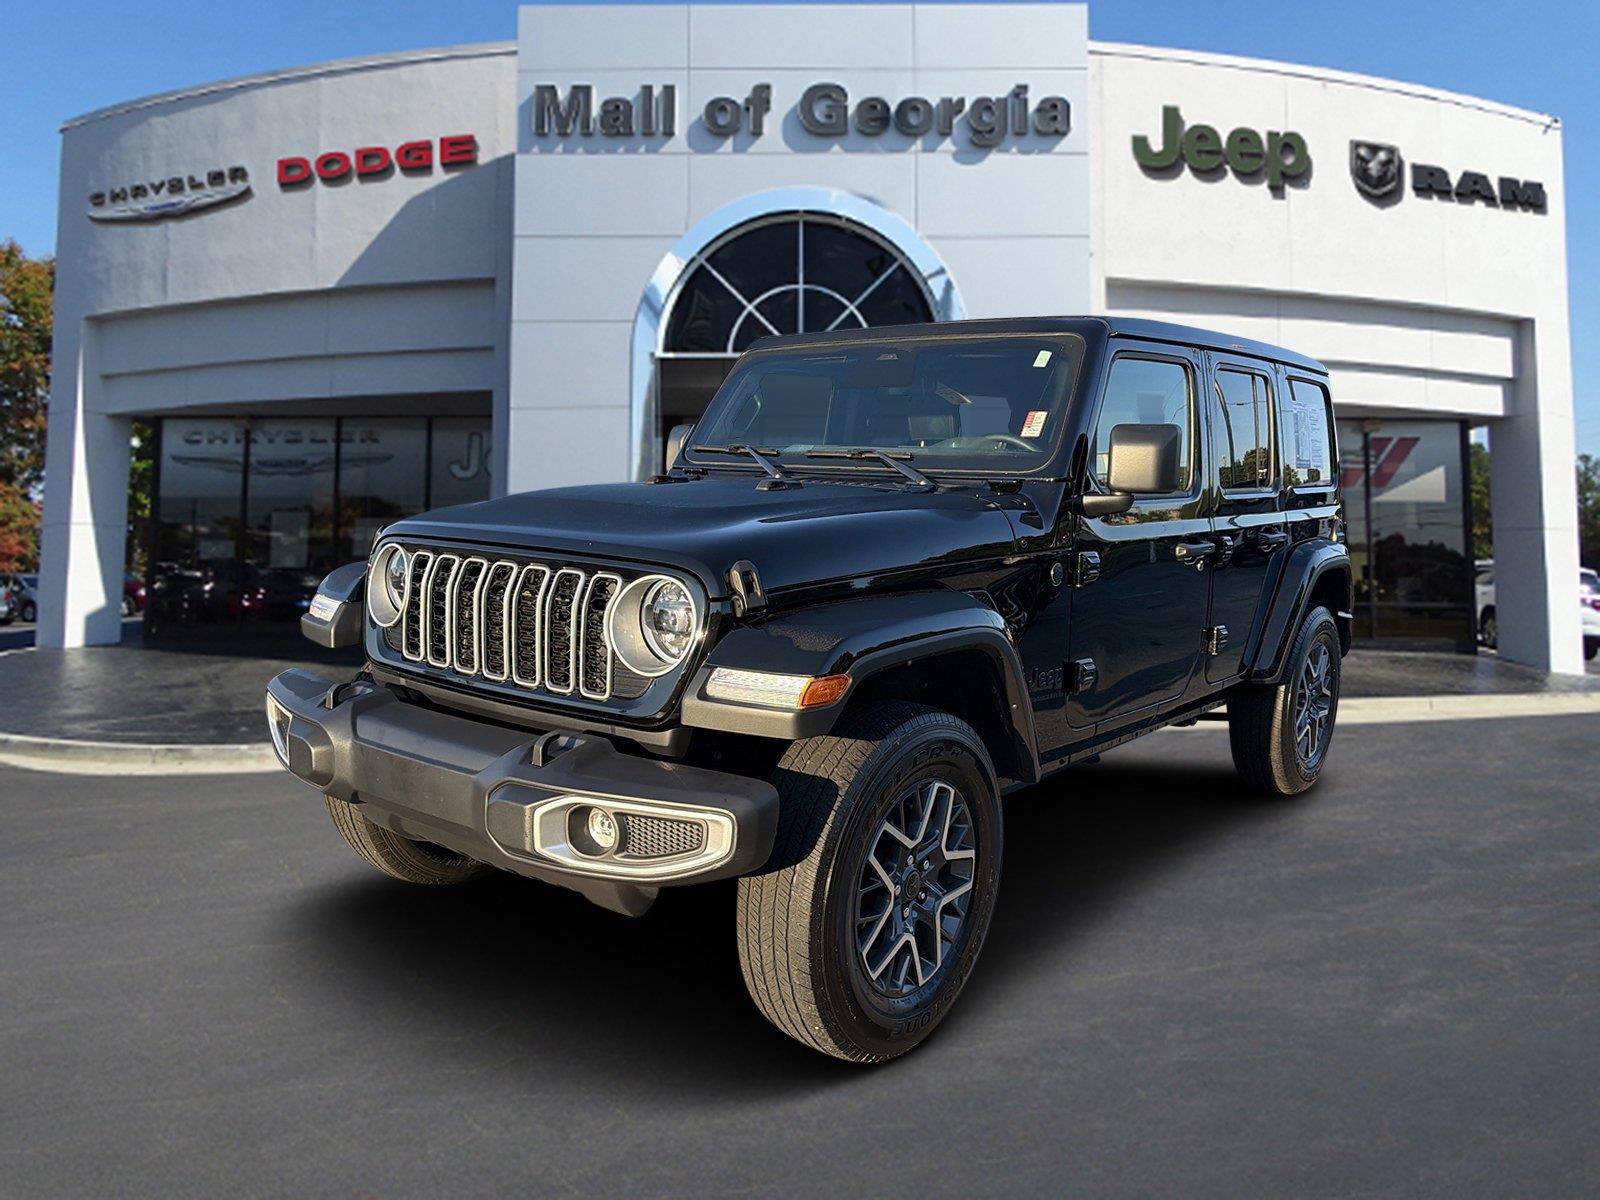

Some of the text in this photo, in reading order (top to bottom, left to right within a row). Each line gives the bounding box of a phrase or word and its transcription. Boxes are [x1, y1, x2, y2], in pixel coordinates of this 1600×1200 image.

[532, 82, 1073, 149] Mall of Georgia
[277, 133, 478, 188] DODGE
[1132, 105, 1310, 195] Jeep
[89, 166, 249, 207] CHRYSLER
[1411, 162, 1547, 215] RAM
[183, 429, 381, 445] CHRYSLER
